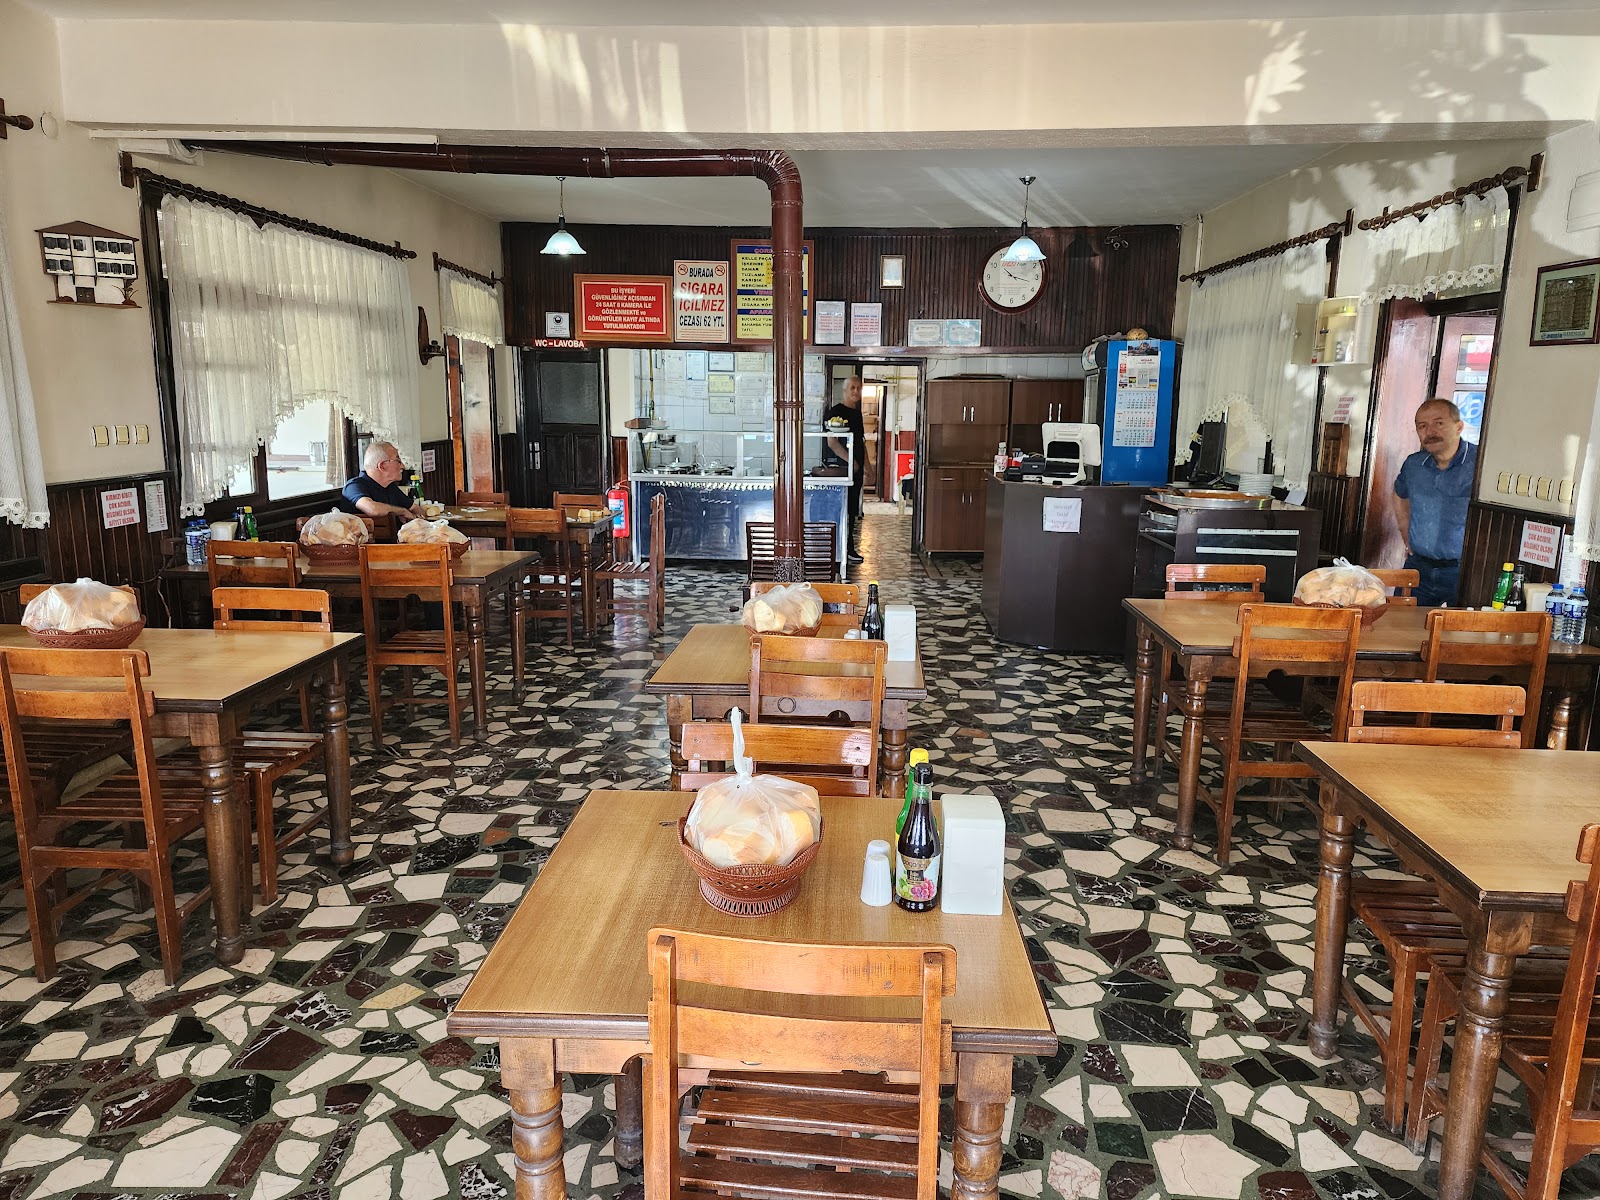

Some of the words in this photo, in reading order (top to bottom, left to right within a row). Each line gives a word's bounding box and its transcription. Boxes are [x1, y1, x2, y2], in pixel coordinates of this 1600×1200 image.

[688, 268, 714, 278] BURADA
[680, 282, 724, 296] SİGARA
[591, 293, 627, 301] GÜVENLİĞİNİZ
[680, 298, 725, 312] İÇİLMEZ
[680, 315, 702, 327] CEZASI
[703, 316, 711, 327] 62
[713, 316, 725, 327] YTL
